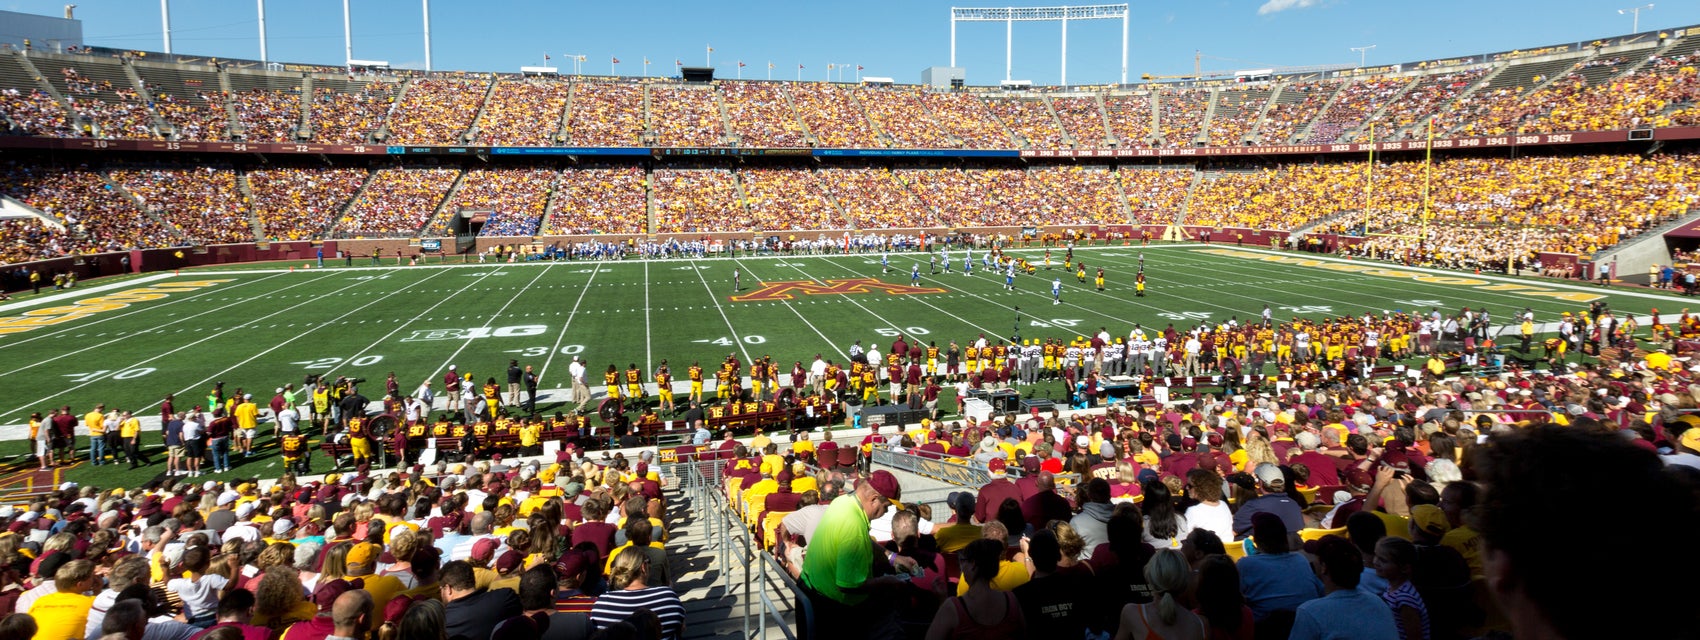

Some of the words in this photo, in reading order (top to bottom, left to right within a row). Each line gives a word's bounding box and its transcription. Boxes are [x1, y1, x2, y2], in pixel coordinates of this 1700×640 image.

[93, 140, 108, 149] 10
[1486, 137, 1508, 145] 1941
[1516, 136, 1539, 144] 1960
[1547, 134, 1573, 143] 1967
[167, 142, 180, 150] 15
[1247, 145, 1321, 153] CHAMPIONSHIPS
[1156, 311, 1214, 321] 30
[1030, 318, 1085, 328] 40
[874, 326, 930, 337] 50
[711, 335, 766, 346] 40
[521, 344, 585, 357] 30
[303, 355, 384, 370] 20
[69, 367, 158, 383] 10
[712, 408, 723, 418] 16
[732, 404, 740, 415] 8
[408, 426, 425, 437] 90
[474, 425, 488, 435] 99
